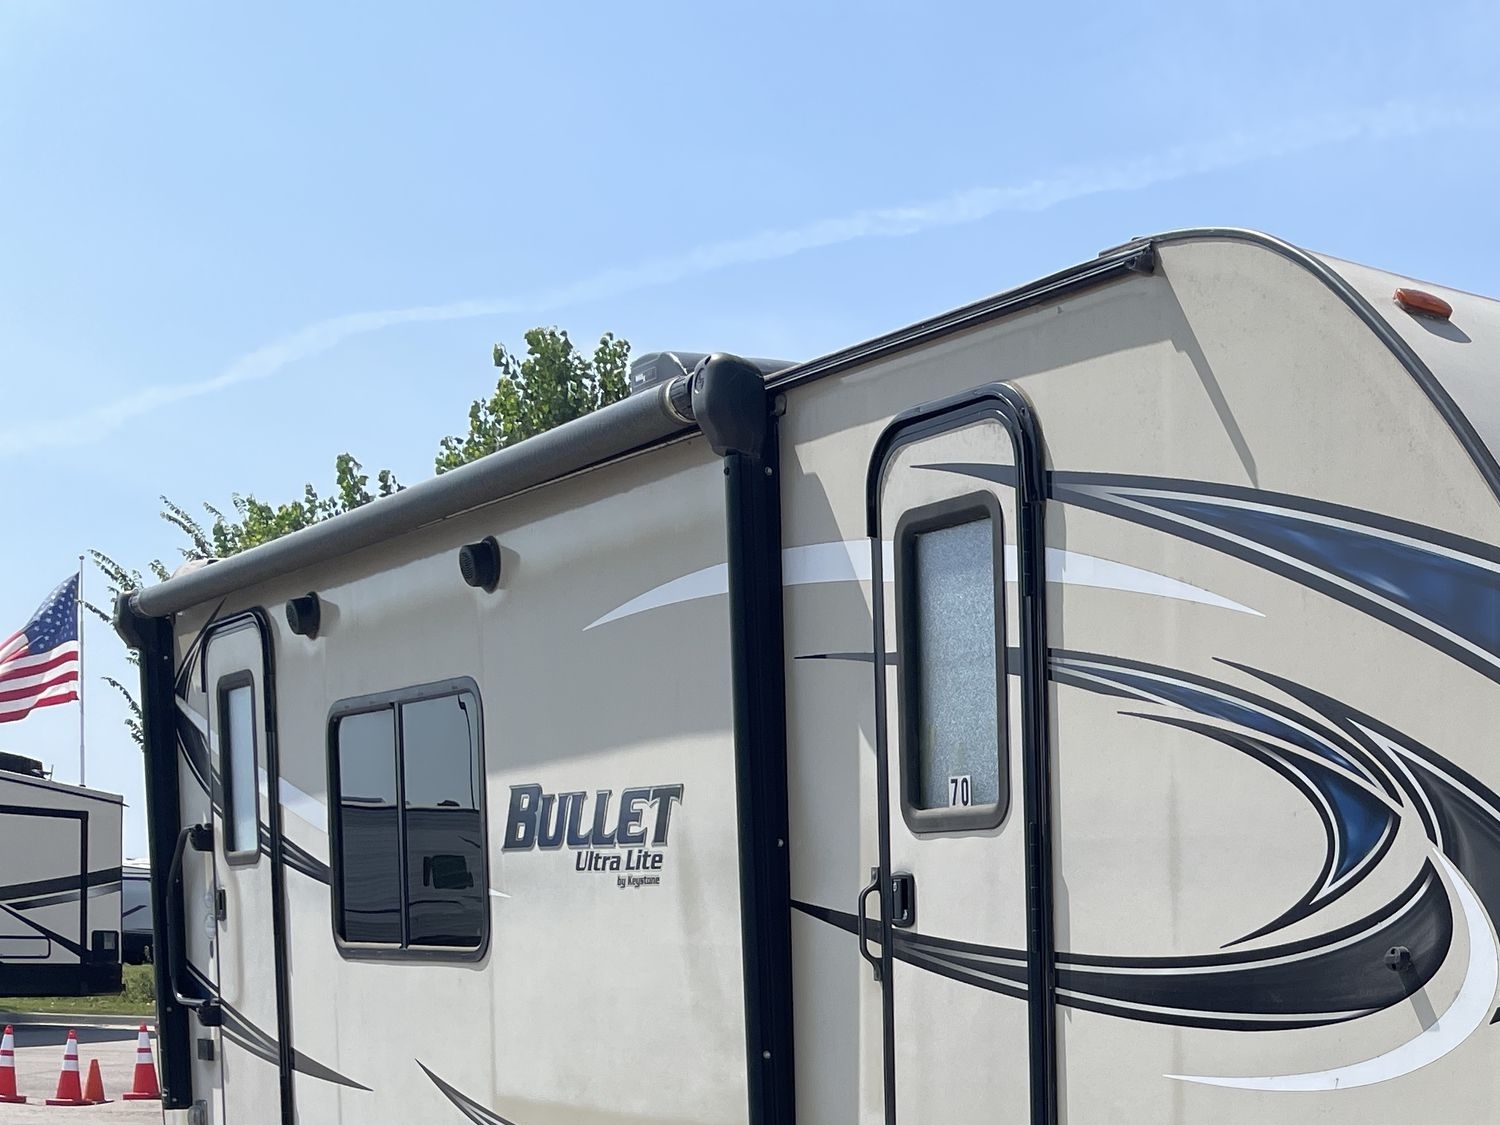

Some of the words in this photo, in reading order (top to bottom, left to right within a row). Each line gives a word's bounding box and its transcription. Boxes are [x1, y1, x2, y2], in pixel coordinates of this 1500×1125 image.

[950, 777, 969, 806] 70
[501, 783, 684, 854] BULLET
[575, 851, 621, 871] Ultra
[625, 849, 663, 871] Lite
[617, 876, 626, 888] by
[627, 877, 660, 888] Keystone
